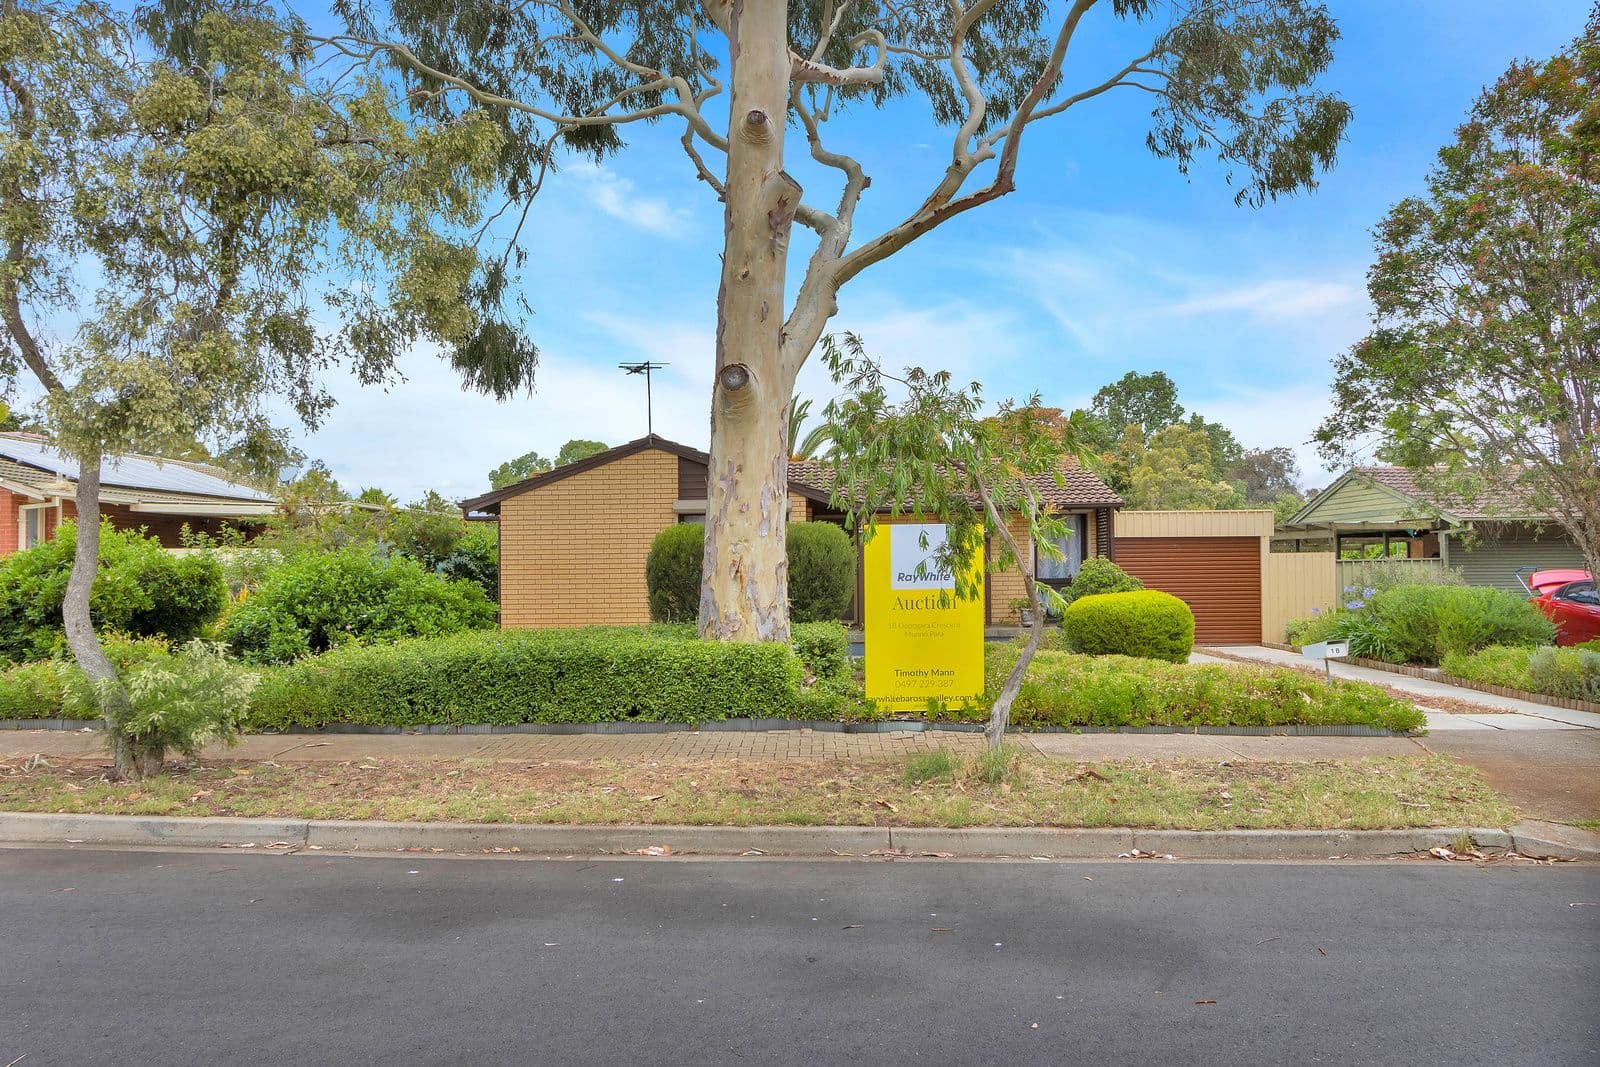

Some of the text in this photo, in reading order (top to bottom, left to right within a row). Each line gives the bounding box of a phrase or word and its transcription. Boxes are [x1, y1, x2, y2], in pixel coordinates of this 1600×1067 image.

[892, 595, 958, 611] Auction
[894, 669, 955, 678] Timothy Mann
